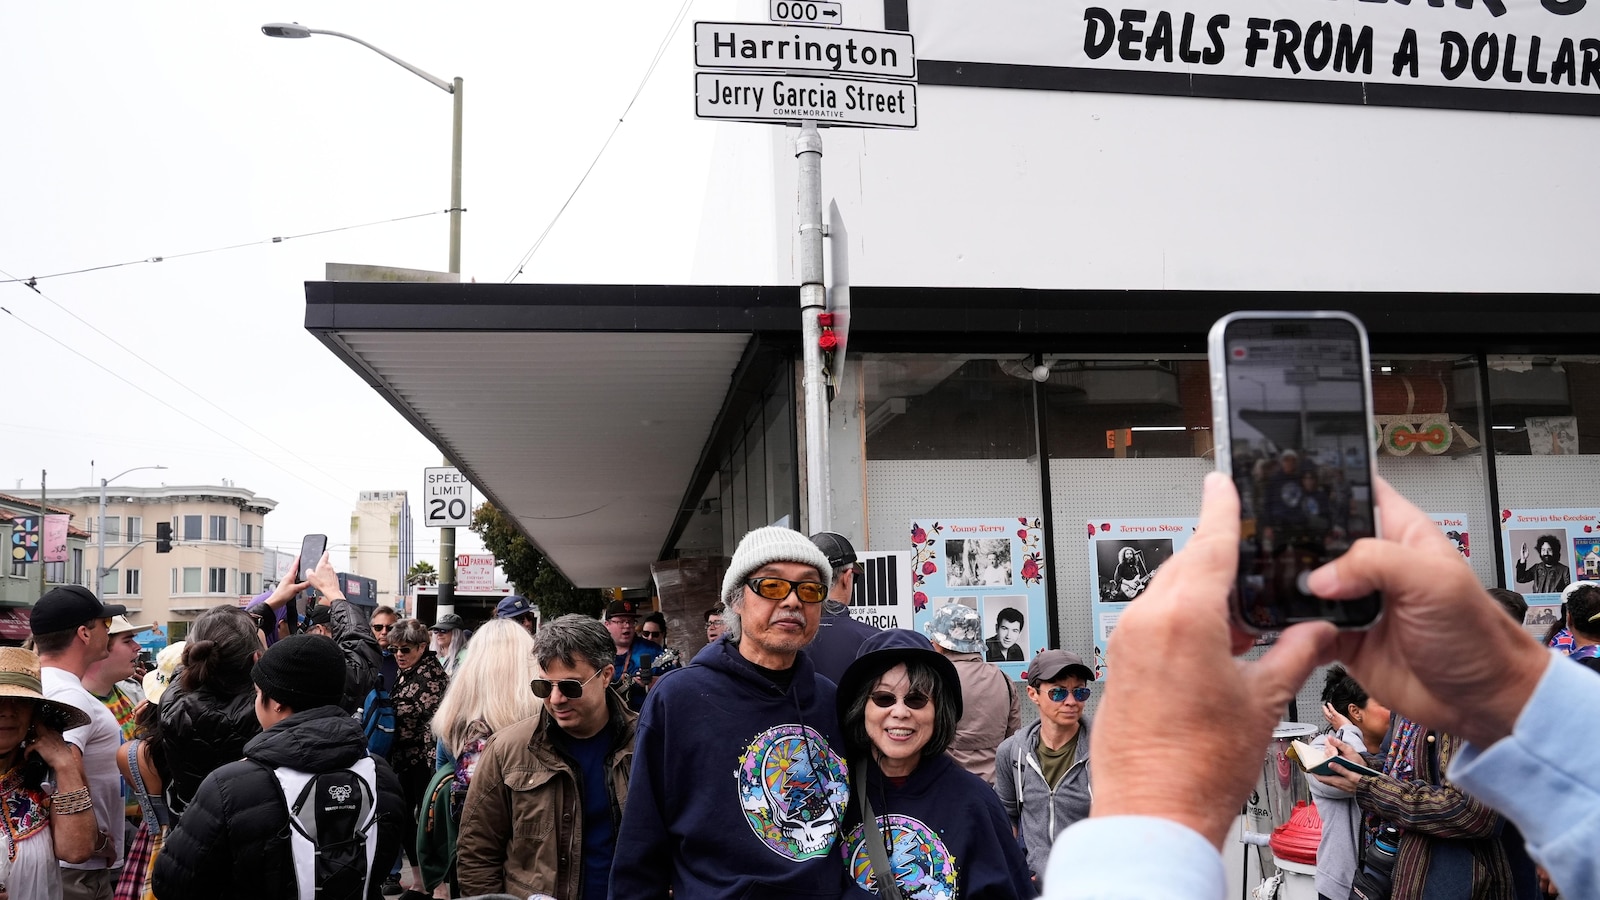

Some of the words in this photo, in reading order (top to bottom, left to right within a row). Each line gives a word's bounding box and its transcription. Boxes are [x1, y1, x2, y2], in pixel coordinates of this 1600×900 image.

[777, 2, 817, 20] 000
[713, 32, 897, 71] Harrington
[1083, 6, 1230, 65] DEALS
[1245, 17, 1373, 75] FROM
[1393, 28, 1419, 78] A
[1440, 30, 1600, 87] DOLLAR
[708, 79, 764, 112] Jerry
[773, 81, 837, 108] Garcia
[845, 85, 905, 114] Street
[773, 108, 844, 118] COMMEMORATIVE
[428, 474, 467, 483] SPEED
[432, 486, 463, 495] LIMIT
[429, 498, 466, 520] 20
[1517, 515, 1539, 523] Jerry
[1563, 514, 1596, 522] Excelsior
[950, 525, 977, 533] Young
[979, 525, 1005, 533] Jerry
[1120, 525, 1145, 533] Jerry
[458, 556, 468, 565] NO
[470, 558, 493, 566] PARKING
